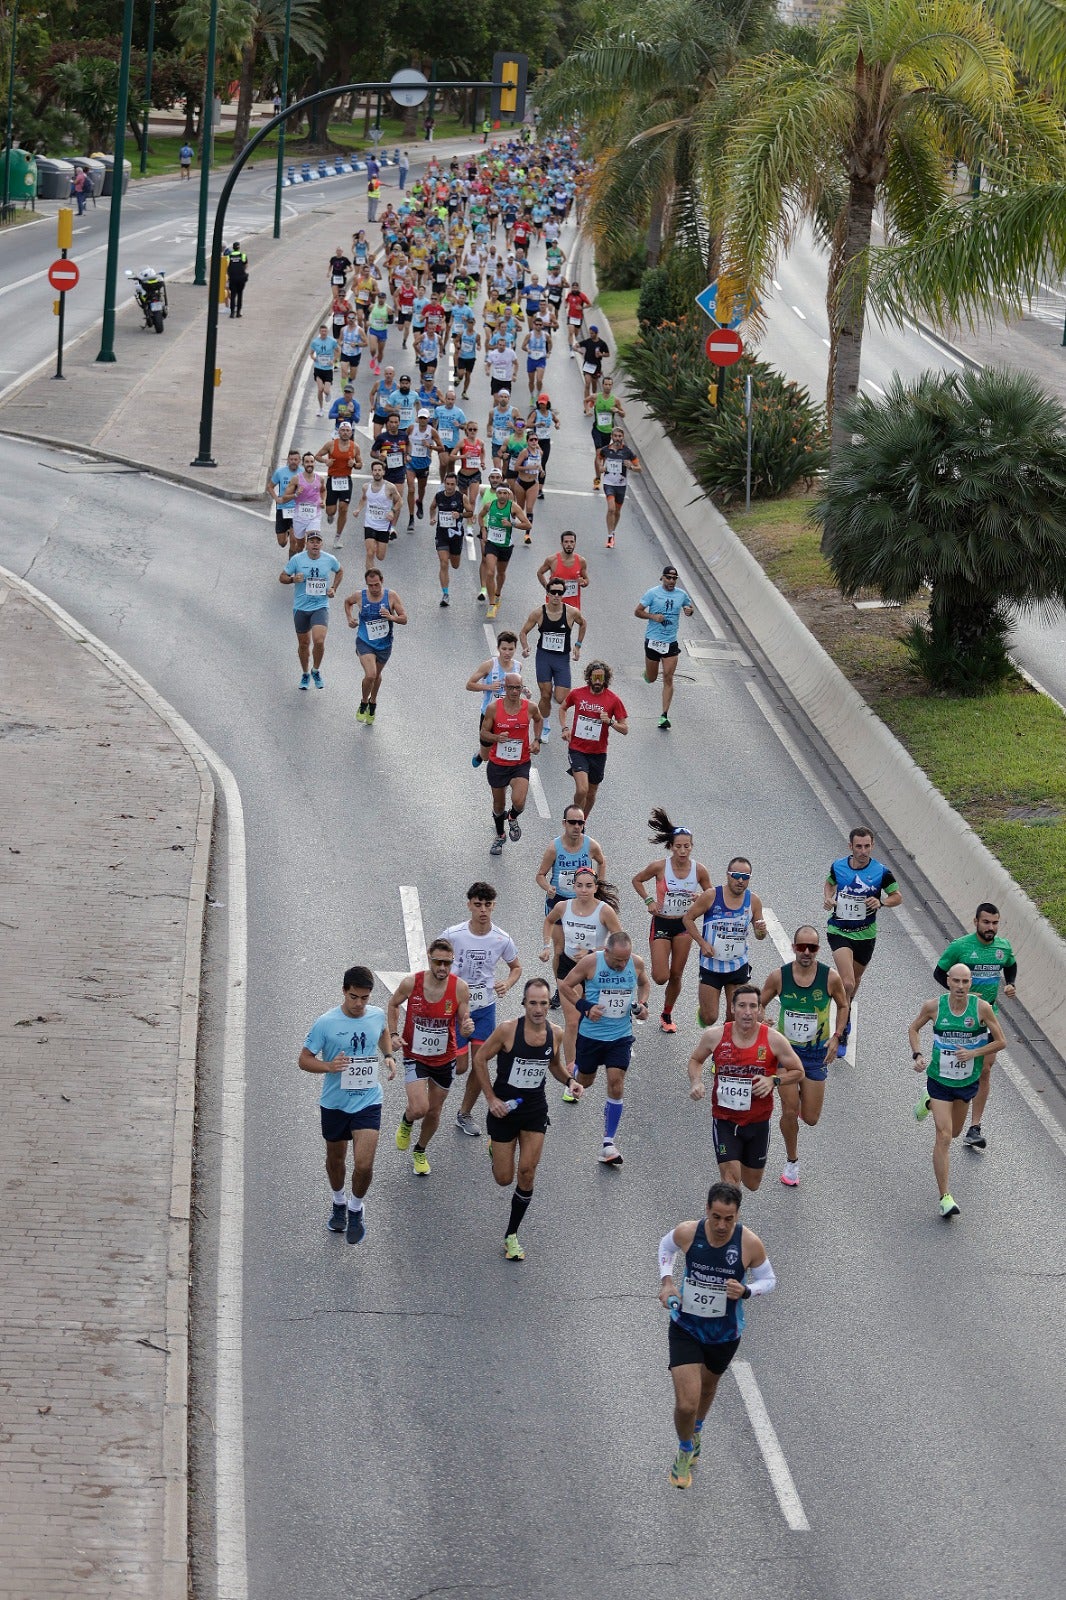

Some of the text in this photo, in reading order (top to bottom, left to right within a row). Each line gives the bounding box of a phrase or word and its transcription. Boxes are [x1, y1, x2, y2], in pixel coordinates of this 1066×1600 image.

[558, 858, 588, 868] nerja
[845, 903, 860, 912] 115
[574, 932, 585, 941] 39
[724, 943, 735, 952] 31
[598, 975, 626, 985] nerja
[607, 998, 625, 1008] 133
[791, 1022, 810, 1033] 175
[421, 1036, 440, 1047] 200
[949, 1060, 967, 1070] 146
[348, 1065, 374, 1077] 3260
[515, 1066, 545, 1078] 11636
[719, 1085, 750, 1099] 11645
[693, 1292, 716, 1306] 267
